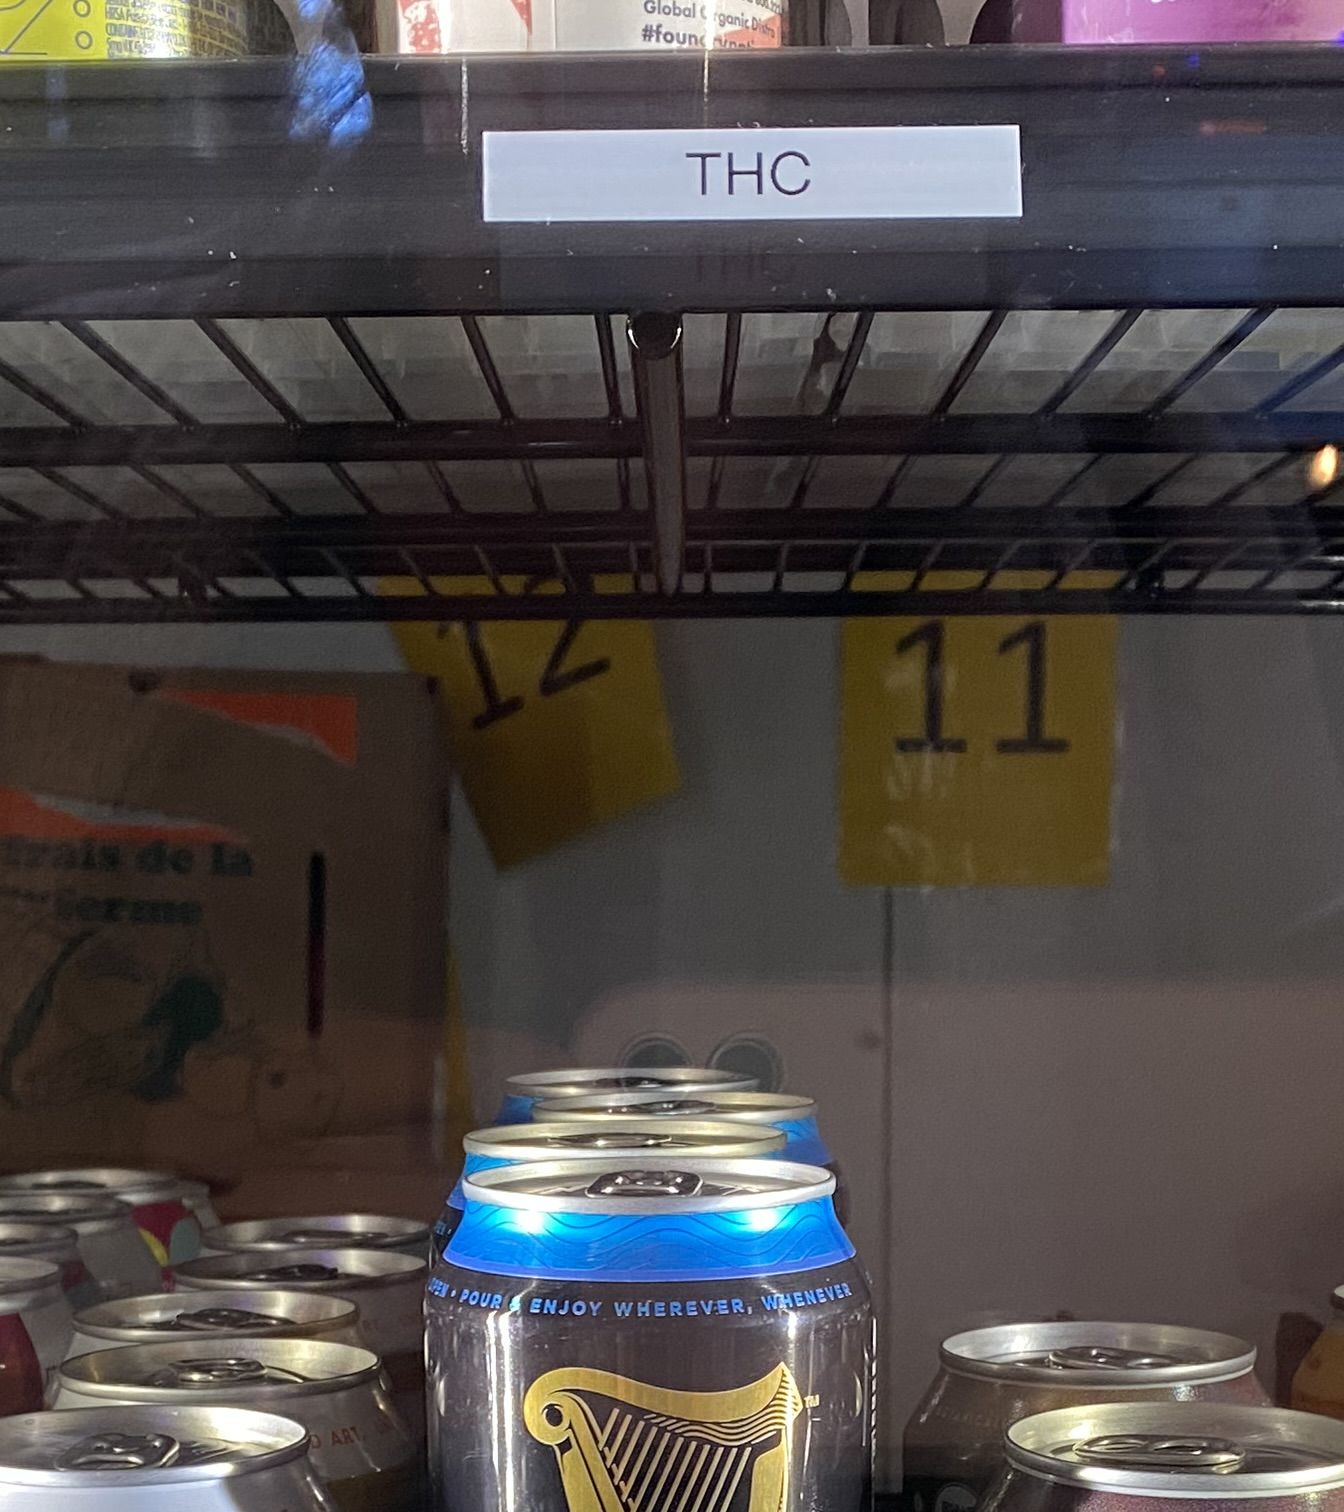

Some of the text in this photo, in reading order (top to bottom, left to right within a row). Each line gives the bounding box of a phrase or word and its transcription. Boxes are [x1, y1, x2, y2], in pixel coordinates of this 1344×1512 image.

[644, 1, 696, 19] Global
[685, 150, 812, 197] THC
[896, 620, 1072, 754] 11
[459, 1281, 853, 1319] POUR ENJOY WHEREVER, WHENEVER
